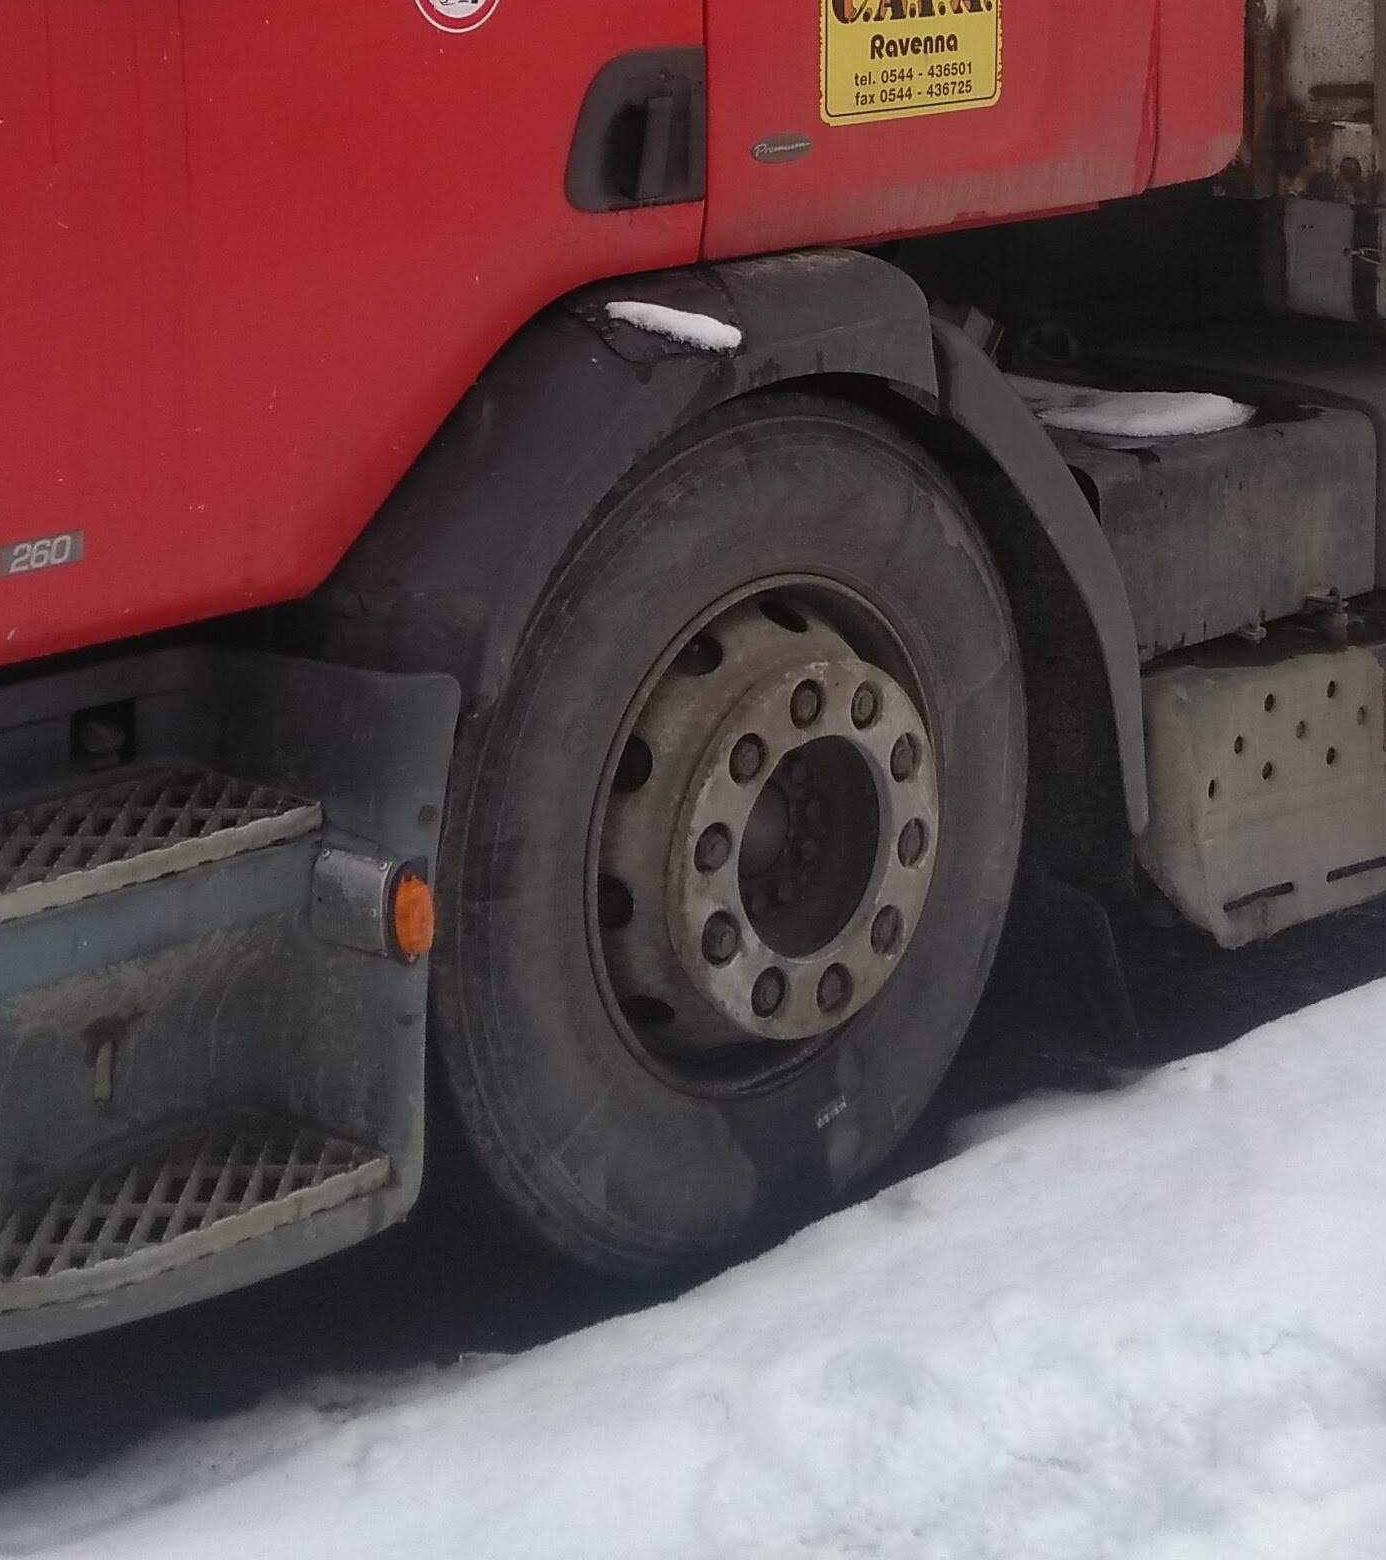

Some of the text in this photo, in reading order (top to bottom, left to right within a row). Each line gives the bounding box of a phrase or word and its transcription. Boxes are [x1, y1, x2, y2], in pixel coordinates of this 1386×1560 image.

[871, 34, 957, 59] Ravenna
[854, 72, 876, 87] tel.
[881, 68, 913, 84] 0544
[927, 62, 972, 78] 436501
[855, 91, 875, 106] fax
[880, 86, 913, 103] 0544
[926, 80, 972, 98] 436725
[754, 142, 811, 158] Premium
[9, 534, 72, 574] 260
